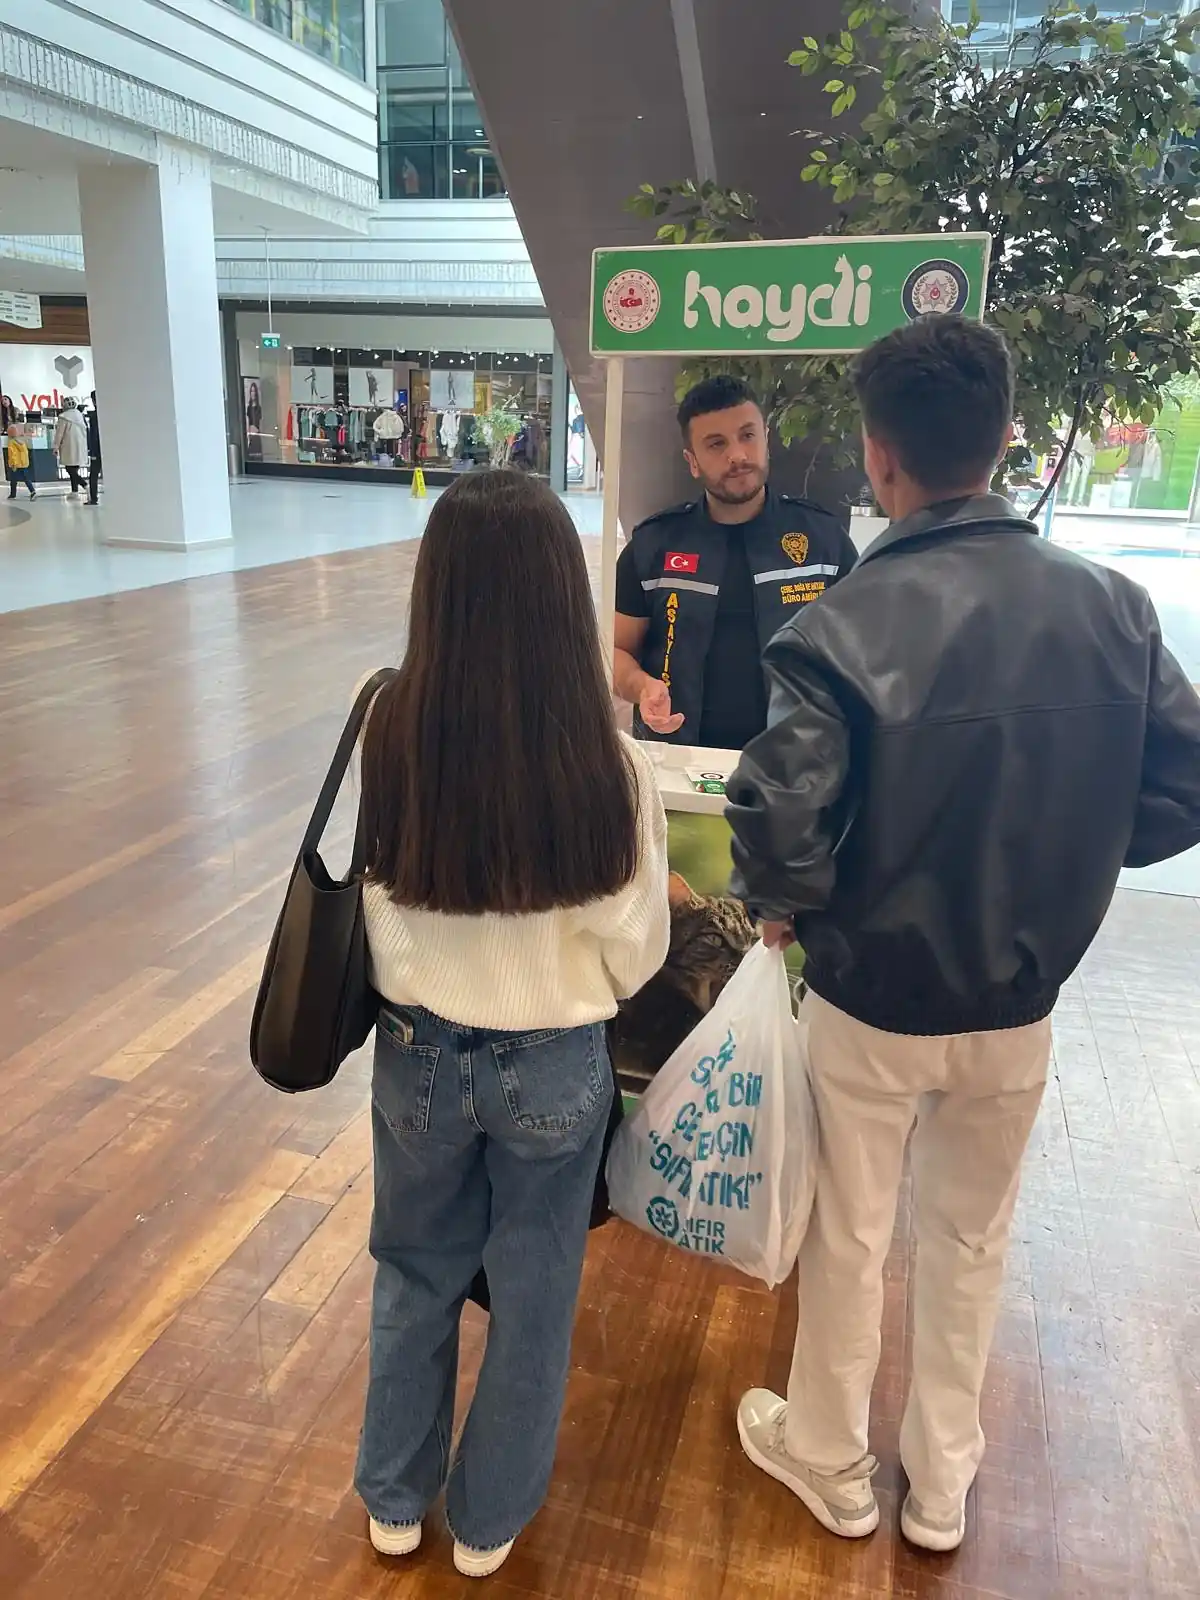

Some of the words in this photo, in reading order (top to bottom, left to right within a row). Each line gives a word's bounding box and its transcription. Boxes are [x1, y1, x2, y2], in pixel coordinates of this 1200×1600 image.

[683, 253, 873, 342] haydi
[782, 593, 801, 604] BÜRO
[686, 1217, 725, 1239] IFIR
[677, 1229, 725, 1255] ATIK
